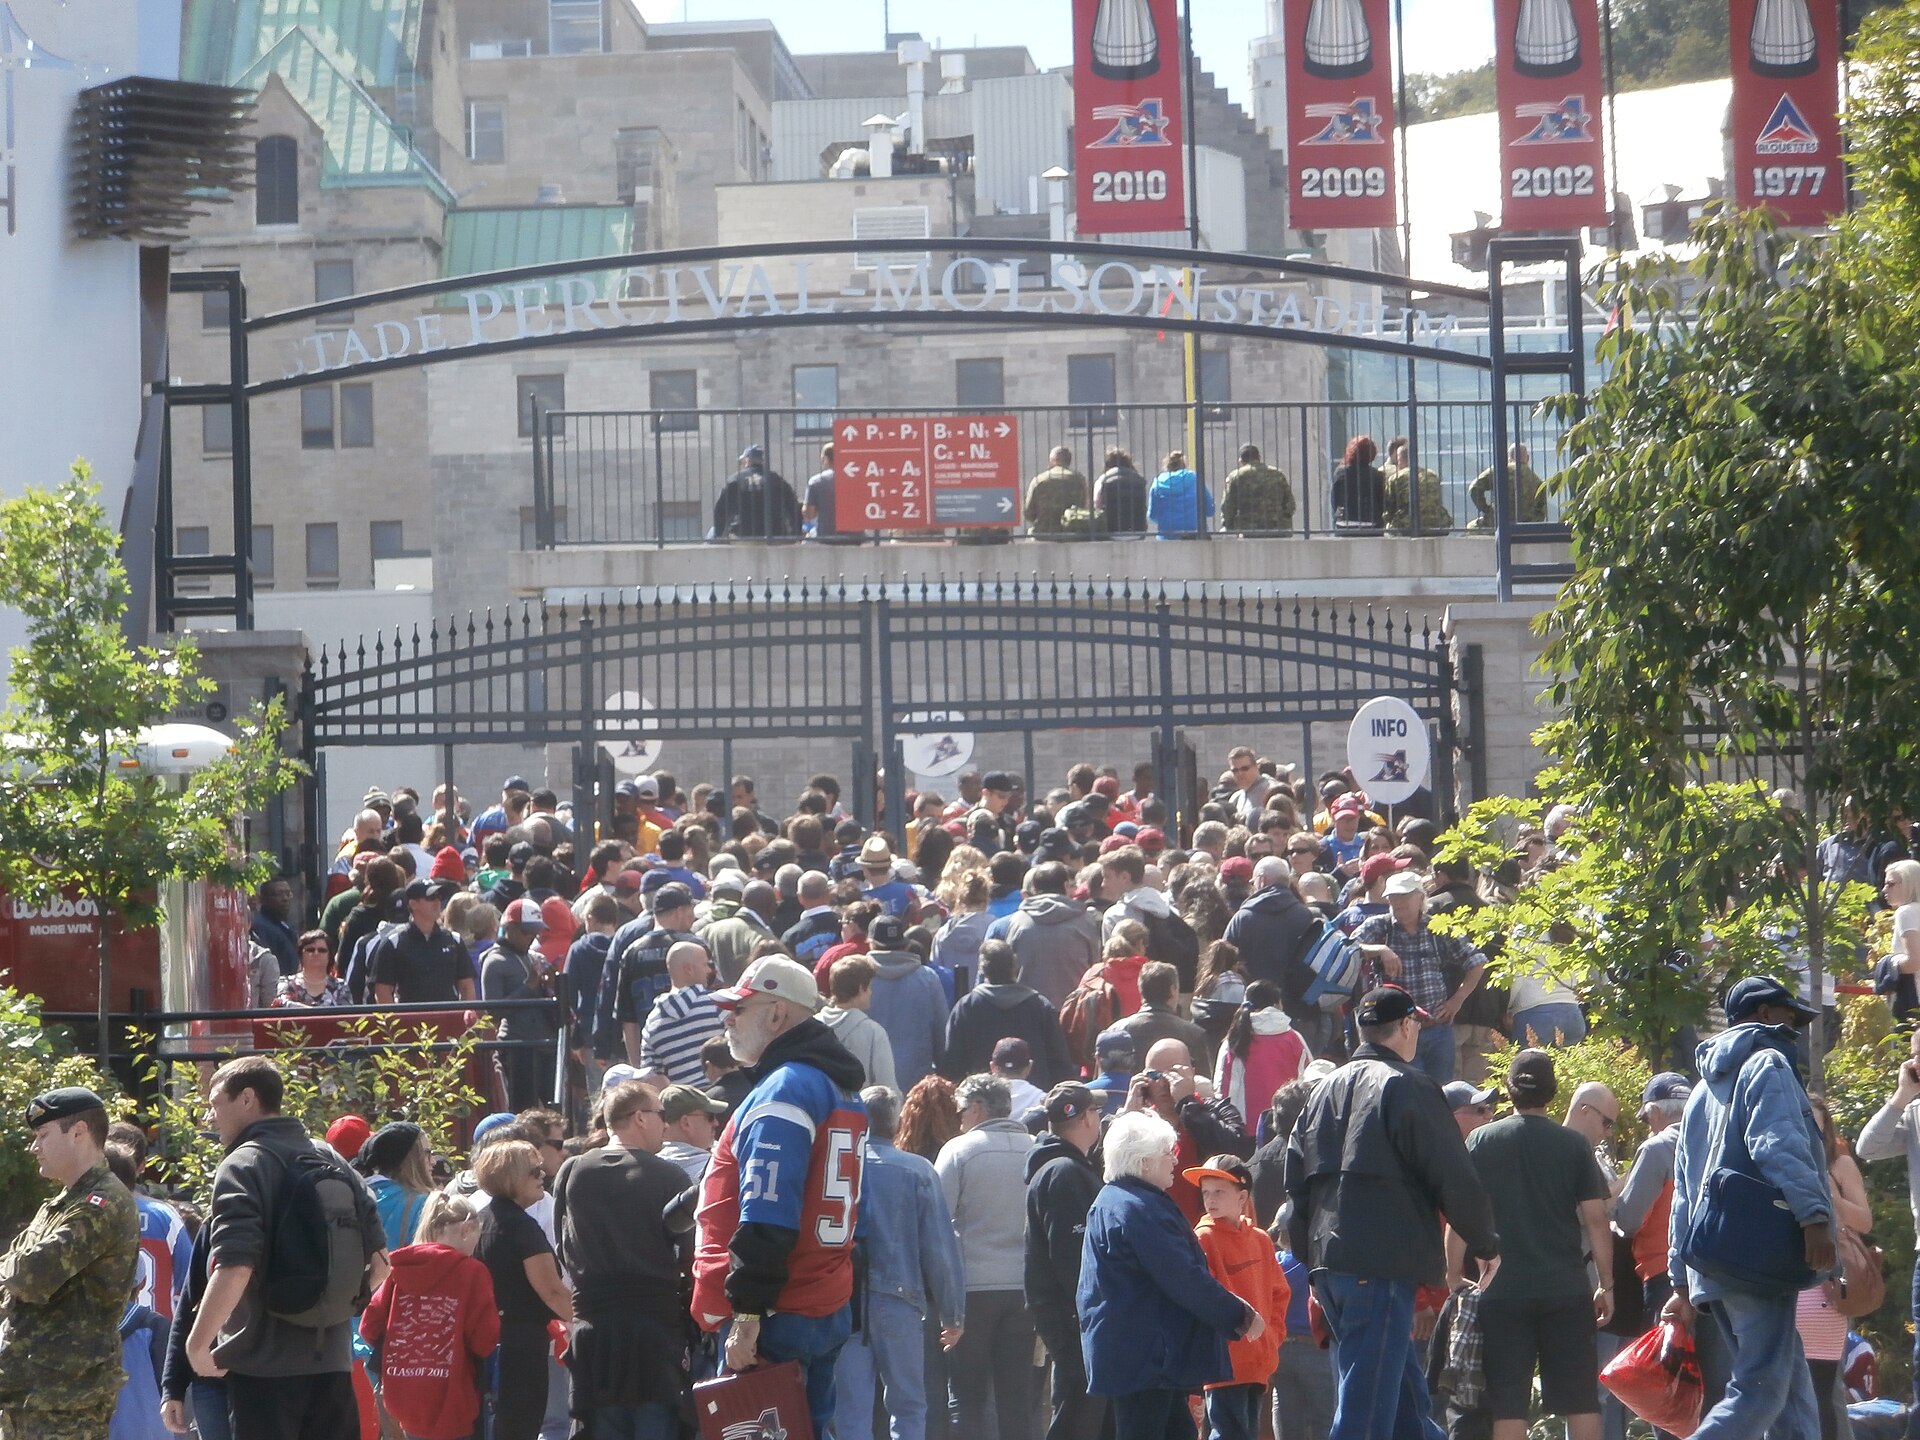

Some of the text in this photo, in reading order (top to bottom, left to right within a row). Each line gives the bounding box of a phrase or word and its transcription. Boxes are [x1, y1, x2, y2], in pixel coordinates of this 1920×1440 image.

[1757, 142, 1818, 154] ALOUETTES
[1091, 169, 1168, 203] 2010
[1301, 166, 1387, 199] 2009
[1511, 164, 1595, 198] 2002
[1752, 165, 1827, 197] 1977
[461, 256, 1208, 346] PERCIVAL-MOLSON
[1213, 286, 1459, 347] STADIUM
[1371, 719, 1408, 737] INFO
[30, 923, 94, 936] MORE WIN.
[743, 1158, 780, 1202] 51
[427, 1367, 450, 1378] 2013
